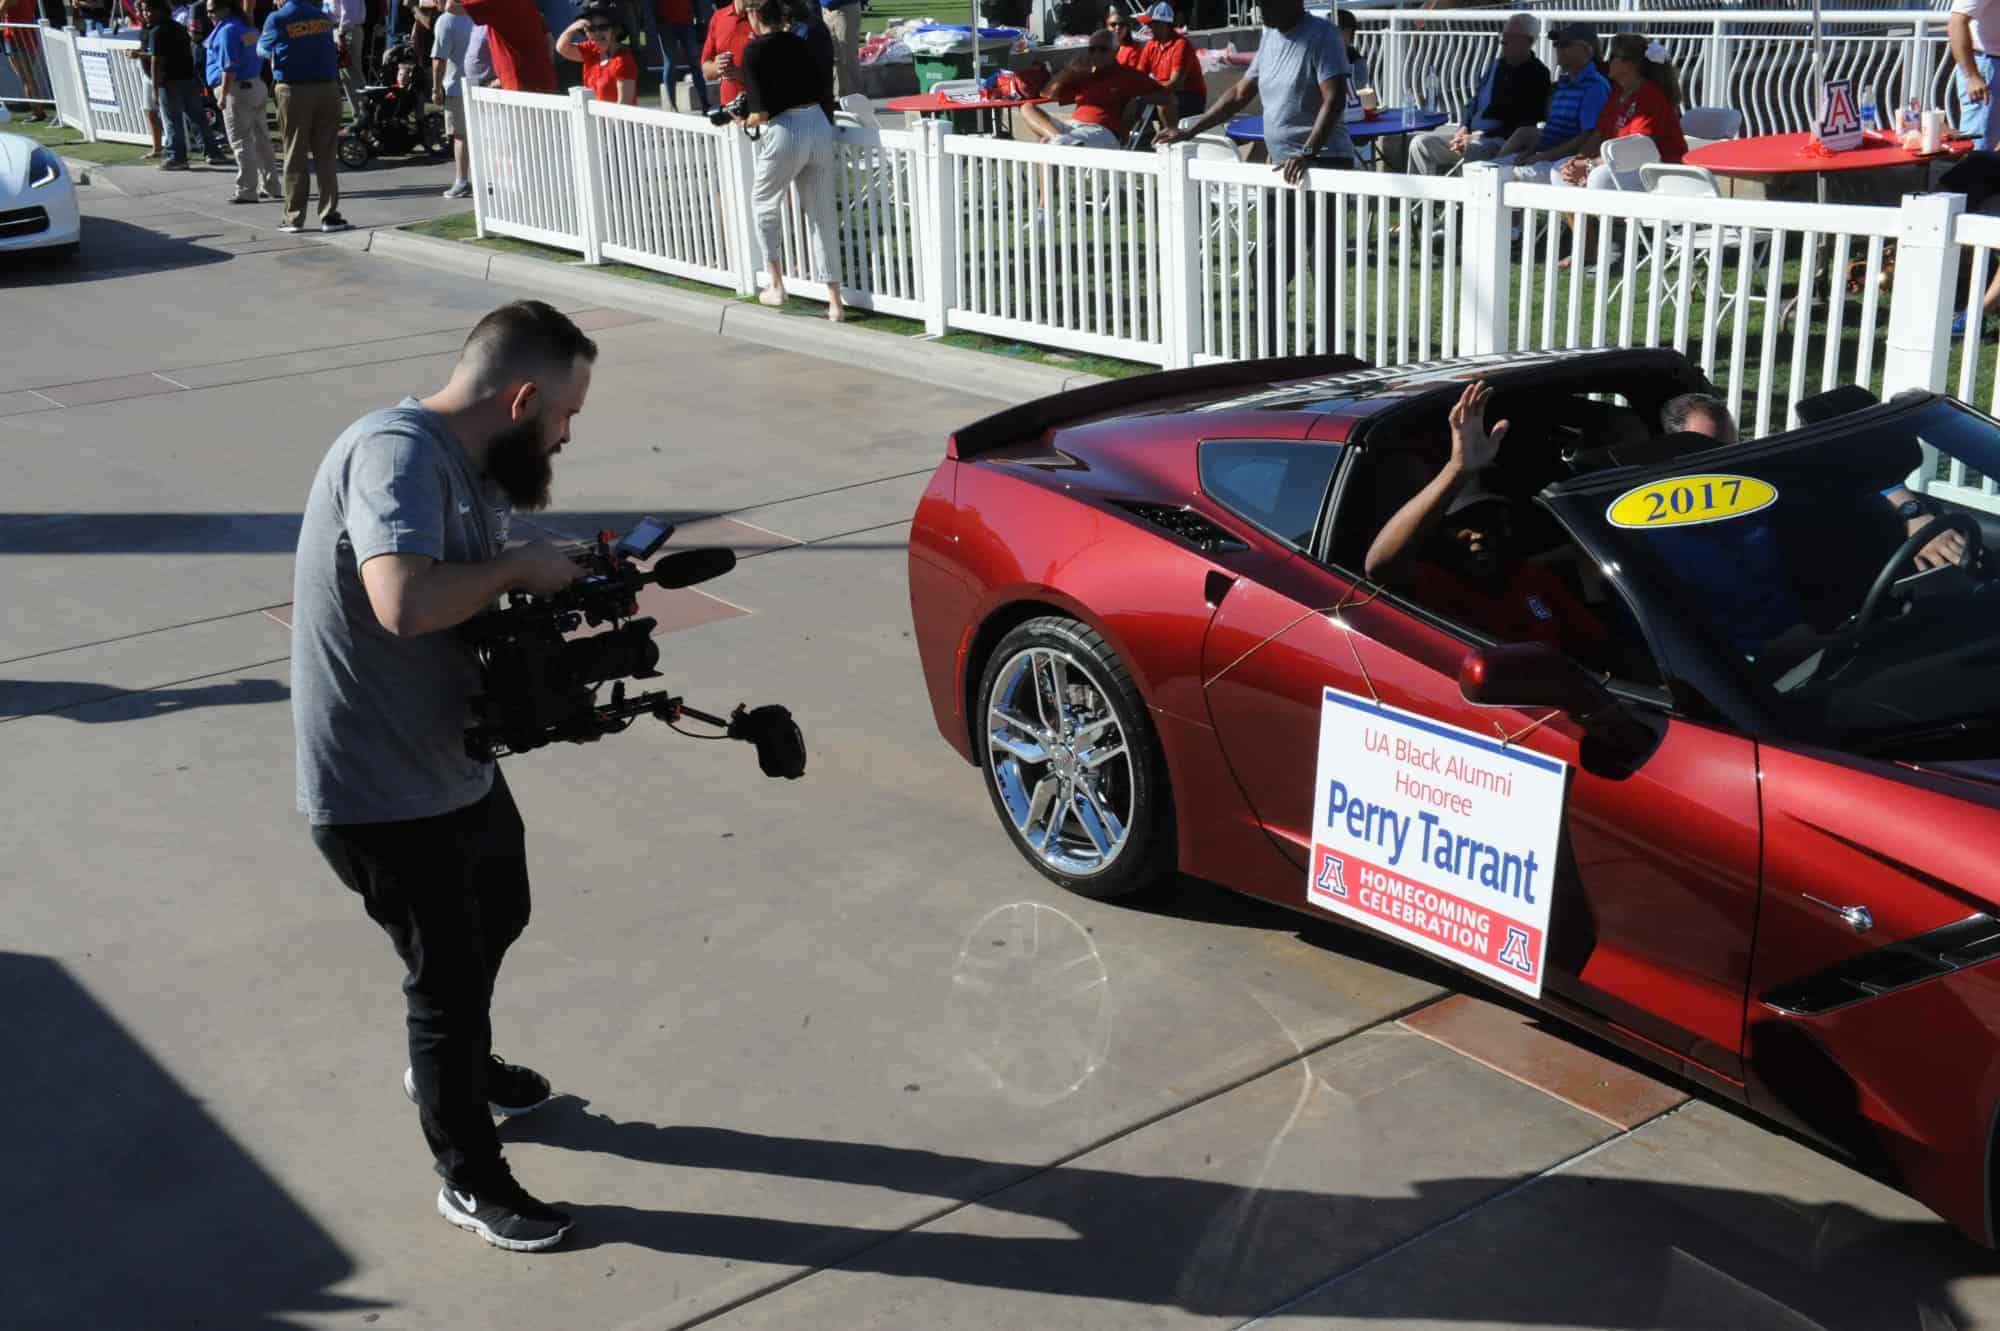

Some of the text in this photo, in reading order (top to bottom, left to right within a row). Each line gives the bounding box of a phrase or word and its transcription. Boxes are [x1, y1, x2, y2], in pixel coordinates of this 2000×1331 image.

[1821, 80, 1861, 137] A
[1643, 479, 1742, 522] 2017
[1364, 727, 1512, 797] UA Black Alumni
[1395, 769, 1473, 817] Honoree
[1328, 779, 1538, 905] Perry Tarrant
[1317, 855, 1347, 897] A
[1360, 867, 1490, 934] HOMECOMING
[1359, 888, 1489, 954] CELEBRATION
[1500, 927, 1532, 973] A
